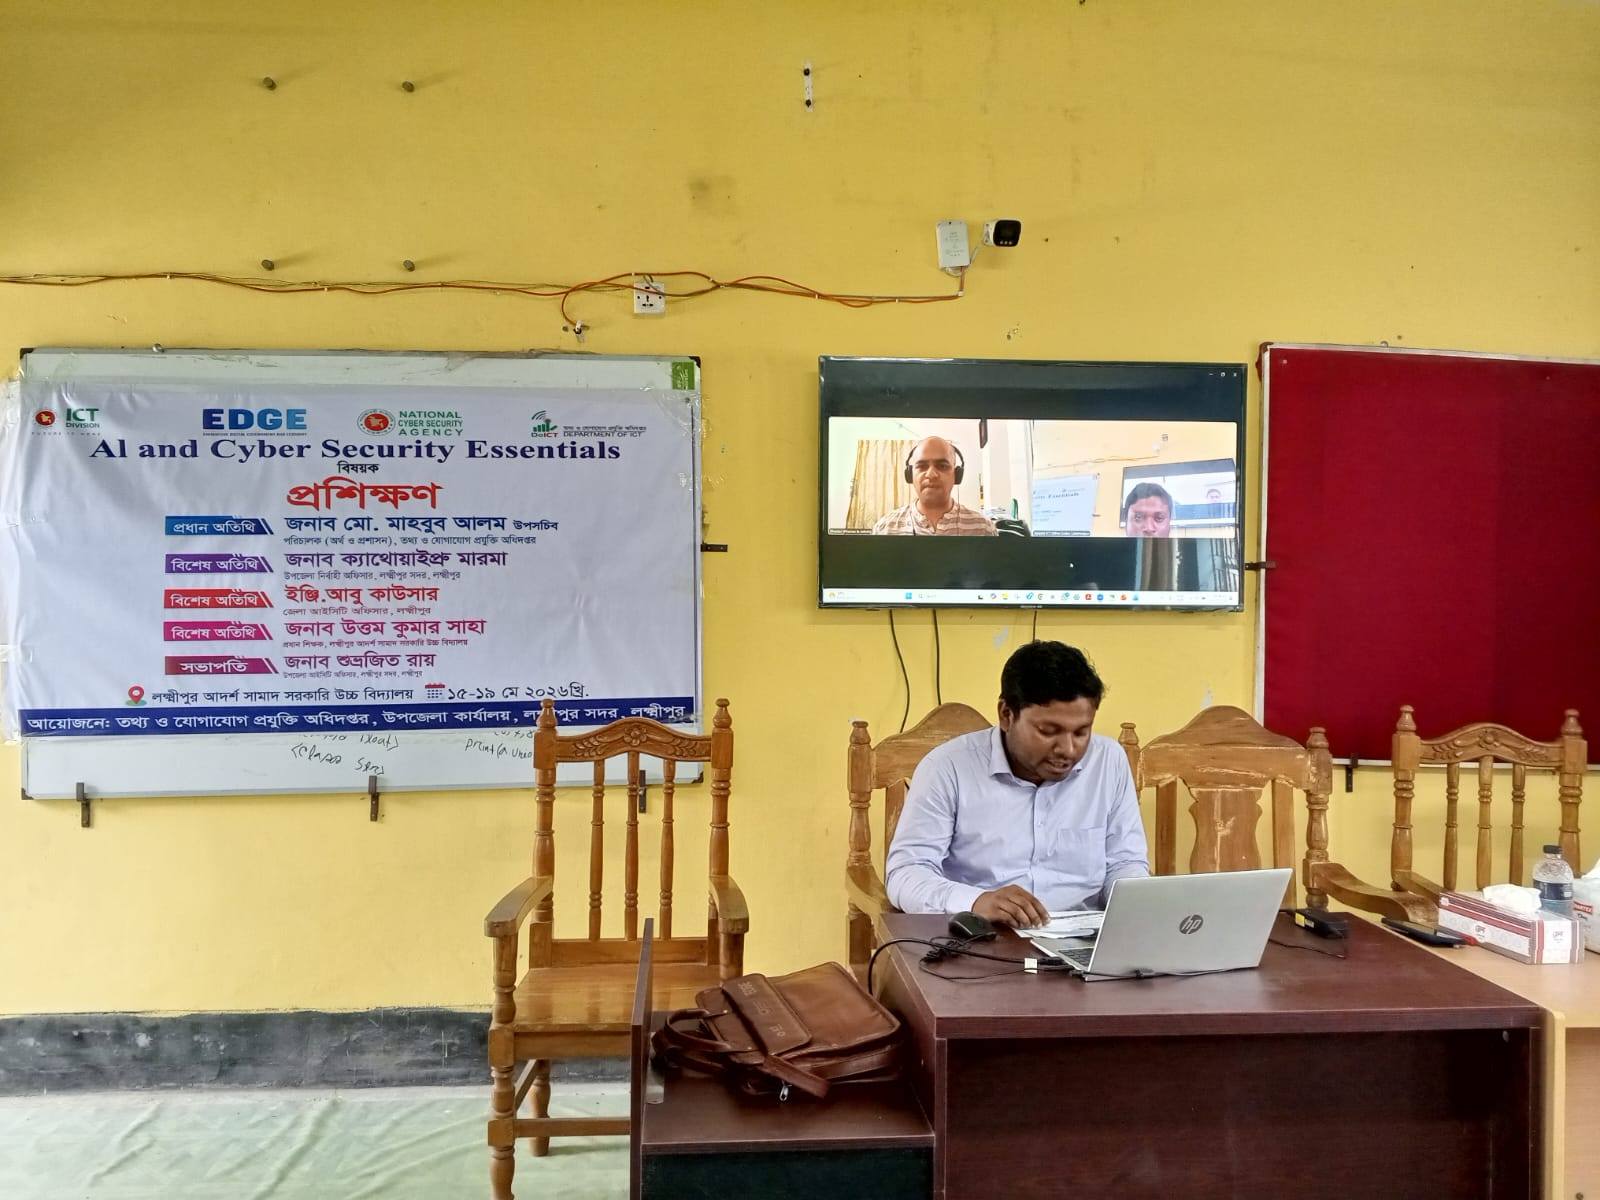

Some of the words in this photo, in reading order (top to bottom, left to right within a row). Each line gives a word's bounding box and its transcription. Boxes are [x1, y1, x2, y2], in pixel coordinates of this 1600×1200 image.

[66, 408, 99, 421] ICT
[203, 408, 307, 430] EDGE
[399, 411, 462, 419] NATIONAL
[398, 420, 424, 428] CYBER
[426, 420, 463, 428] SECURITY
[139, 439, 198, 457] and
[211, 439, 311, 463] Cyber
[321, 439, 454, 463] Security
[465, 440, 620, 459] Essentials
[337, 460, 379, 474] বিষয়ক
[287, 476, 444, 511] প্রশিক্ষণ
[173, 523, 208, 533] প্রধান
[213, 520, 256, 533] অতিথি
[284, 517, 337, 531] জনাব
[343, 517, 378, 531] মো.
[386, 517, 447, 534] মাহবুব
[452, 516, 507, 531] আলম
[513, 519, 559, 531] উপসচিব
[171, 558, 212, 571] বিশেষ
[216, 557, 259, 571] অতিথি
[284, 552, 335, 567] জনাব
[456, 551, 508, 566] মারমা
[170, 594, 211, 606] বিশেষ
[215, 594, 258, 606] অতিথি
[368, 584, 439, 602] কাউসার
[171, 626, 211, 639] বিশেষ
[213, 626, 256, 638] অতিথি
[284, 621, 335, 636] জনাব
[340, 618, 386, 635] উত্তম
[391, 619, 441, 638] কুমার
[445, 619, 487, 635] সাহা
[180, 660, 248, 673] সভাপতি
[284, 655, 331, 669] জনাব
[336, 651, 401, 668] শুভ্রজিত
[405, 653, 437, 668] রায়
[203, 689, 239, 702] আদর্শ
[244, 690, 280, 702] সামাদ
[284, 688, 330, 702] সরকারি
[334, 688, 359, 700] উচ্চ
[364, 687, 414, 700] বিদ্যালয়
[448, 687, 495, 699] ১৫-১৯
[502, 686, 519, 698] মে
[115, 717, 150, 729] তথ্য
[155, 717, 168, 728] ও
[174, 715, 248, 728] যোগাযোগ
[253, 712, 299, 729] প্রযুক্তি
[381, 710, 448, 724] উপজেলা
[1180, 914, 1204, 935] hp
